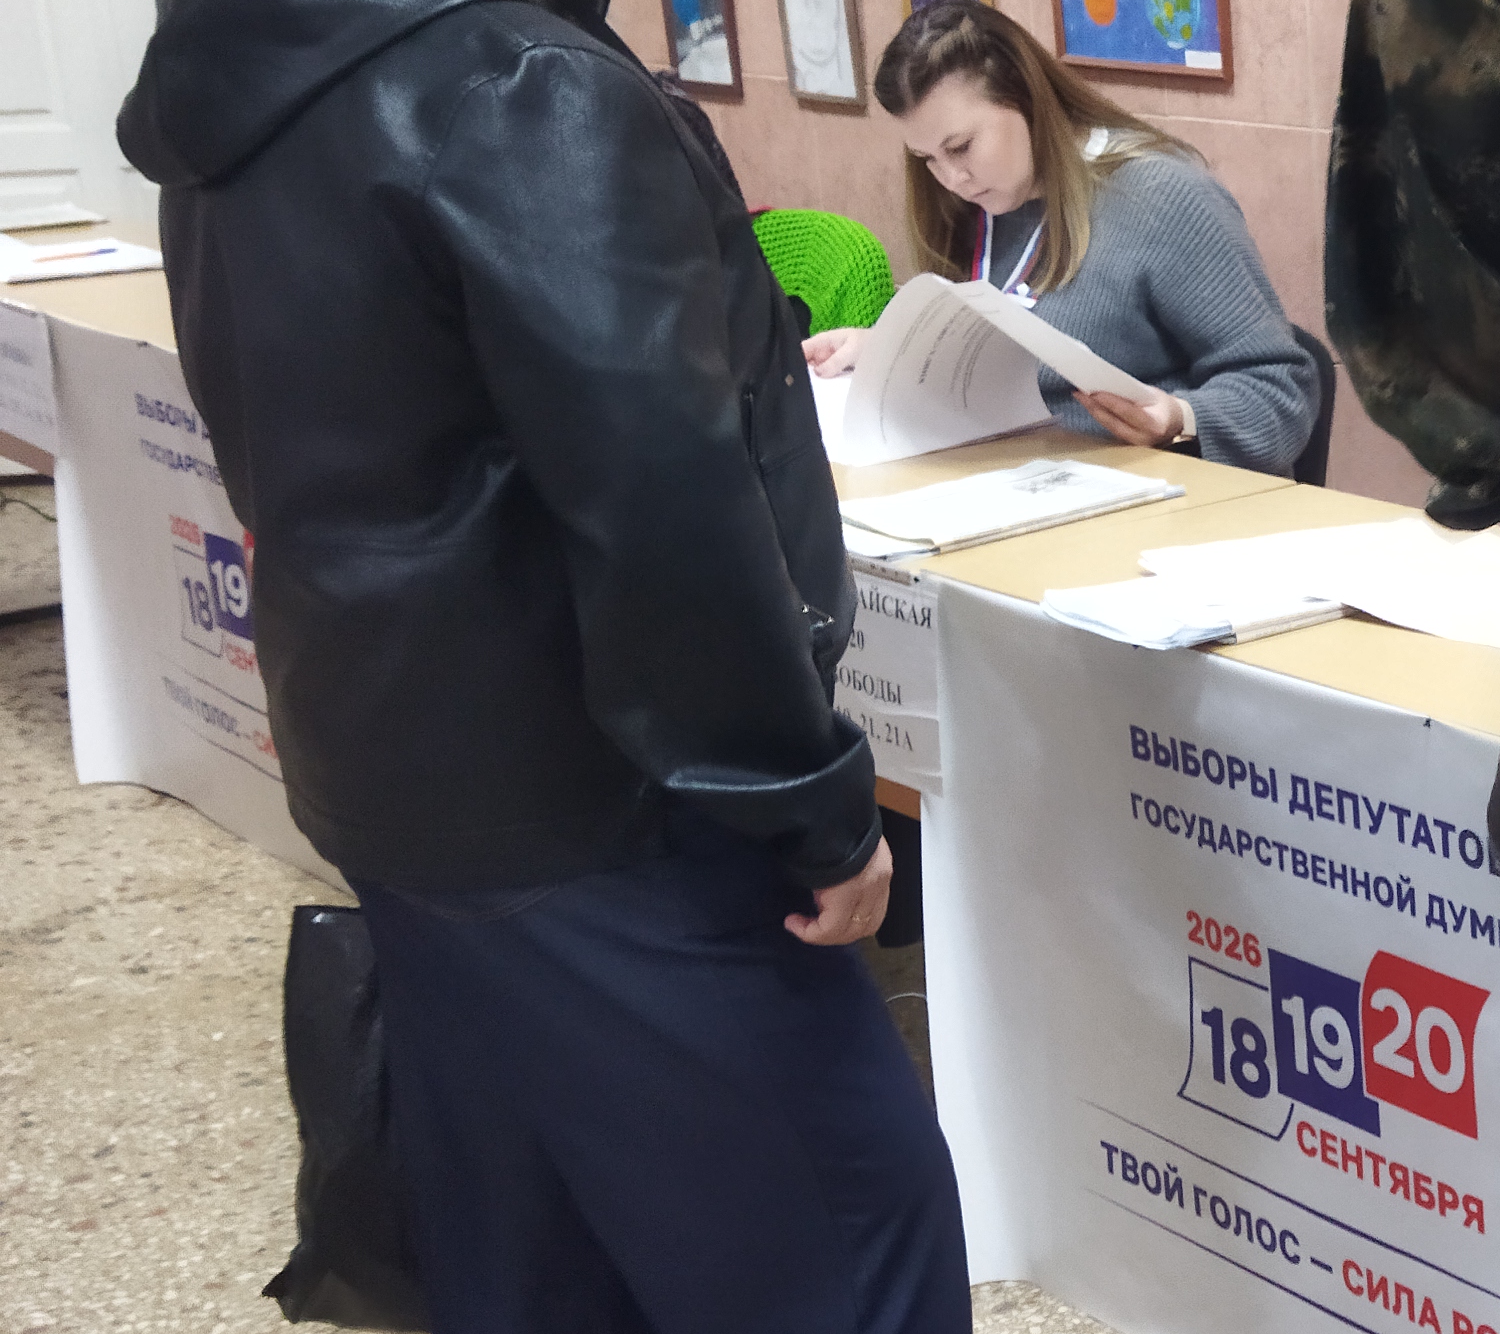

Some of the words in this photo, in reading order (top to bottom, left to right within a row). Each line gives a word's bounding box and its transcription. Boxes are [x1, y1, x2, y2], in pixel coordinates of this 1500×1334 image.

[183, 578, 213, 631] 18
[210, 559, 248, 618] 19
[859, 587, 932, 630] АЙСКАЯ
[1129, 724, 1279, 804] ВЫБОРЫ
[1130, 791, 1416, 917] ГОСУДАРСТВЕННОЙ
[1186, 910, 1262, 967] 2026
[1200, 1006, 1271, 1099] 18
[1281, 995, 1354, 1089] 19
[1370, 987, 1466, 1094] 20
[1100, 1140, 1184, 1209] ТВОЙ
[1192, 1184, 1300, 1265] ГОЛОС
[1296, 1120, 1485, 1234] СЕНТЯБРЯ
